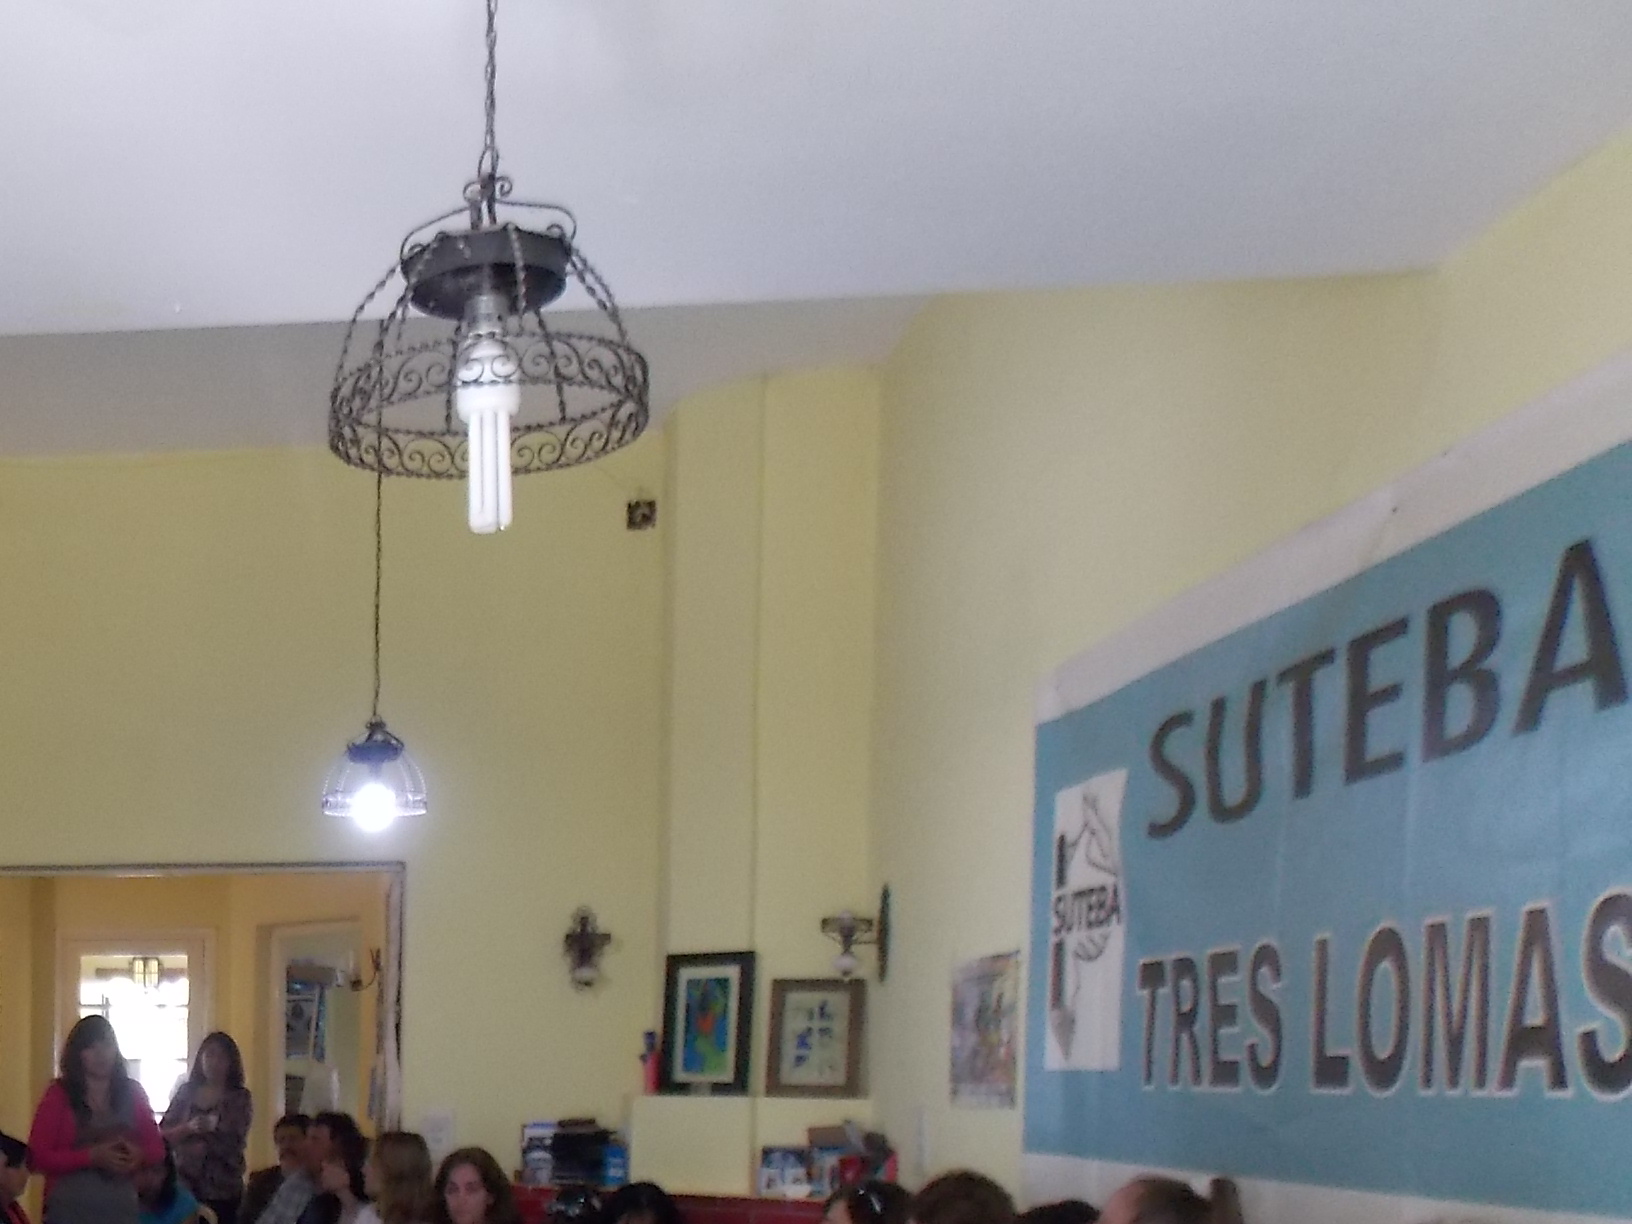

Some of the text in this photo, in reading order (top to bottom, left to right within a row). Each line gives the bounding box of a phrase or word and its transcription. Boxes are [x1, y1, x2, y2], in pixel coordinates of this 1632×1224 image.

[1147, 538, 1631, 840] SUTEBA
[1053, 883, 1121, 935] SUTEBA
[1138, 888, 1632, 1100] TRES LOMAS
